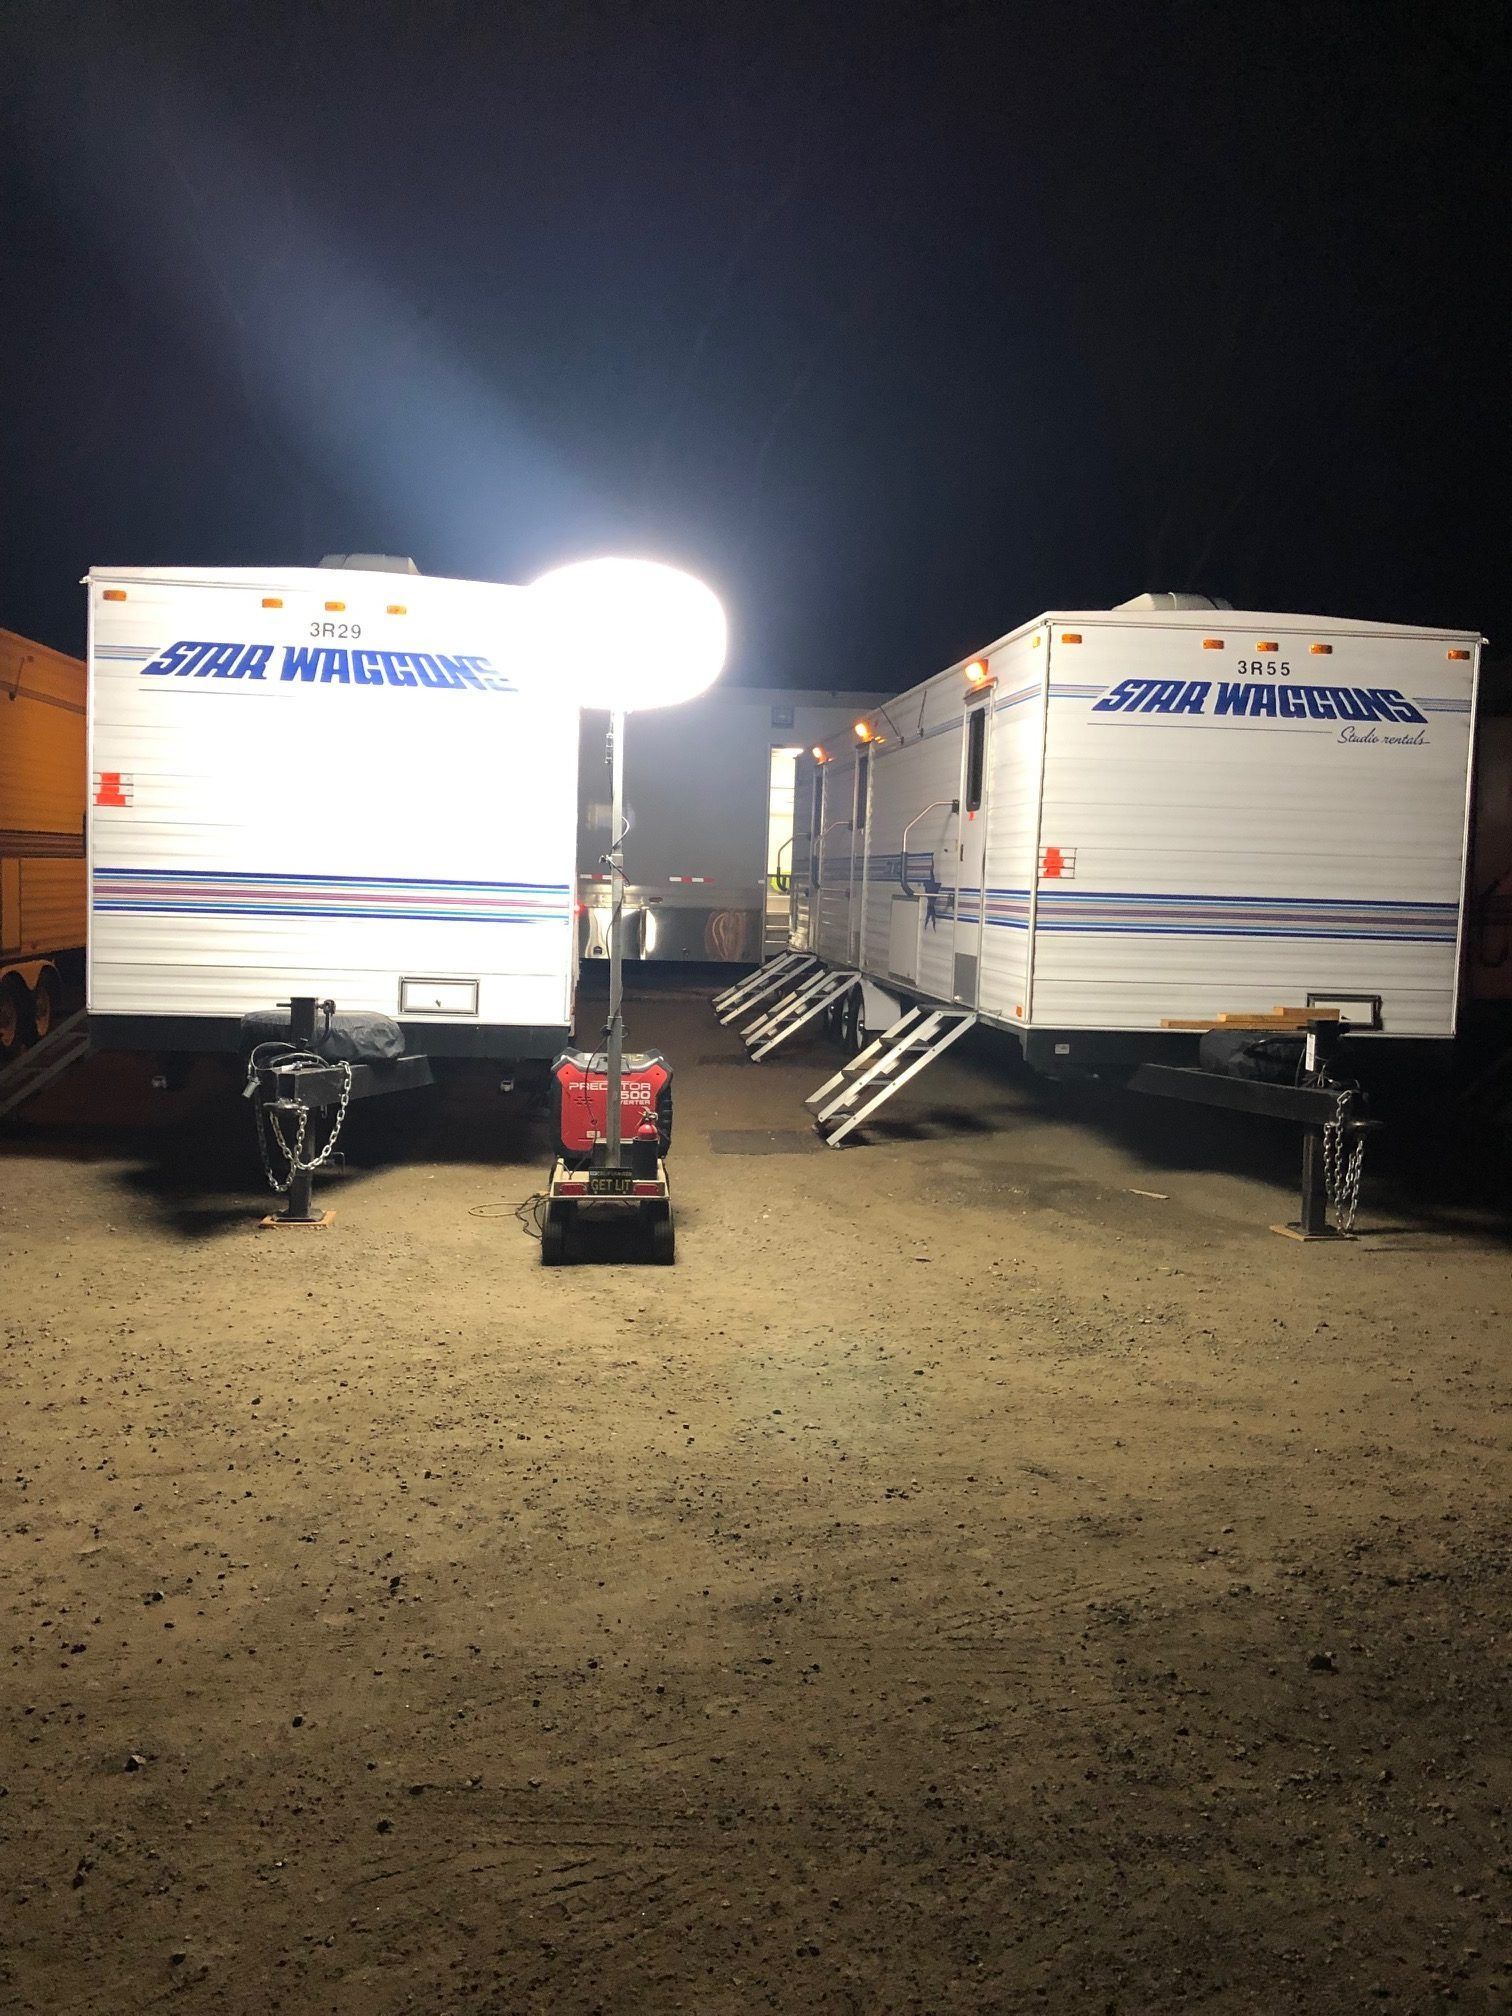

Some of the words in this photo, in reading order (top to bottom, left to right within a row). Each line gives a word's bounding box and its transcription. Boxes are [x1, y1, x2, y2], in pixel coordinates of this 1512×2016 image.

[310, 622, 361, 639] 3R29
[140, 640, 274, 680] STAR
[280, 645, 519, 692] WAGGONS
[1238, 660, 1290, 676] 3R55
[1091, 678, 1212, 714] STAR
[1213, 682, 1428, 723] WAGGONS
[1337, 726, 1379, 744] Studio
[1383, 729, 1430, 745] rentals
[591, 1178, 613, 1191] GET
[615, 1178, 631, 1191] LIT
